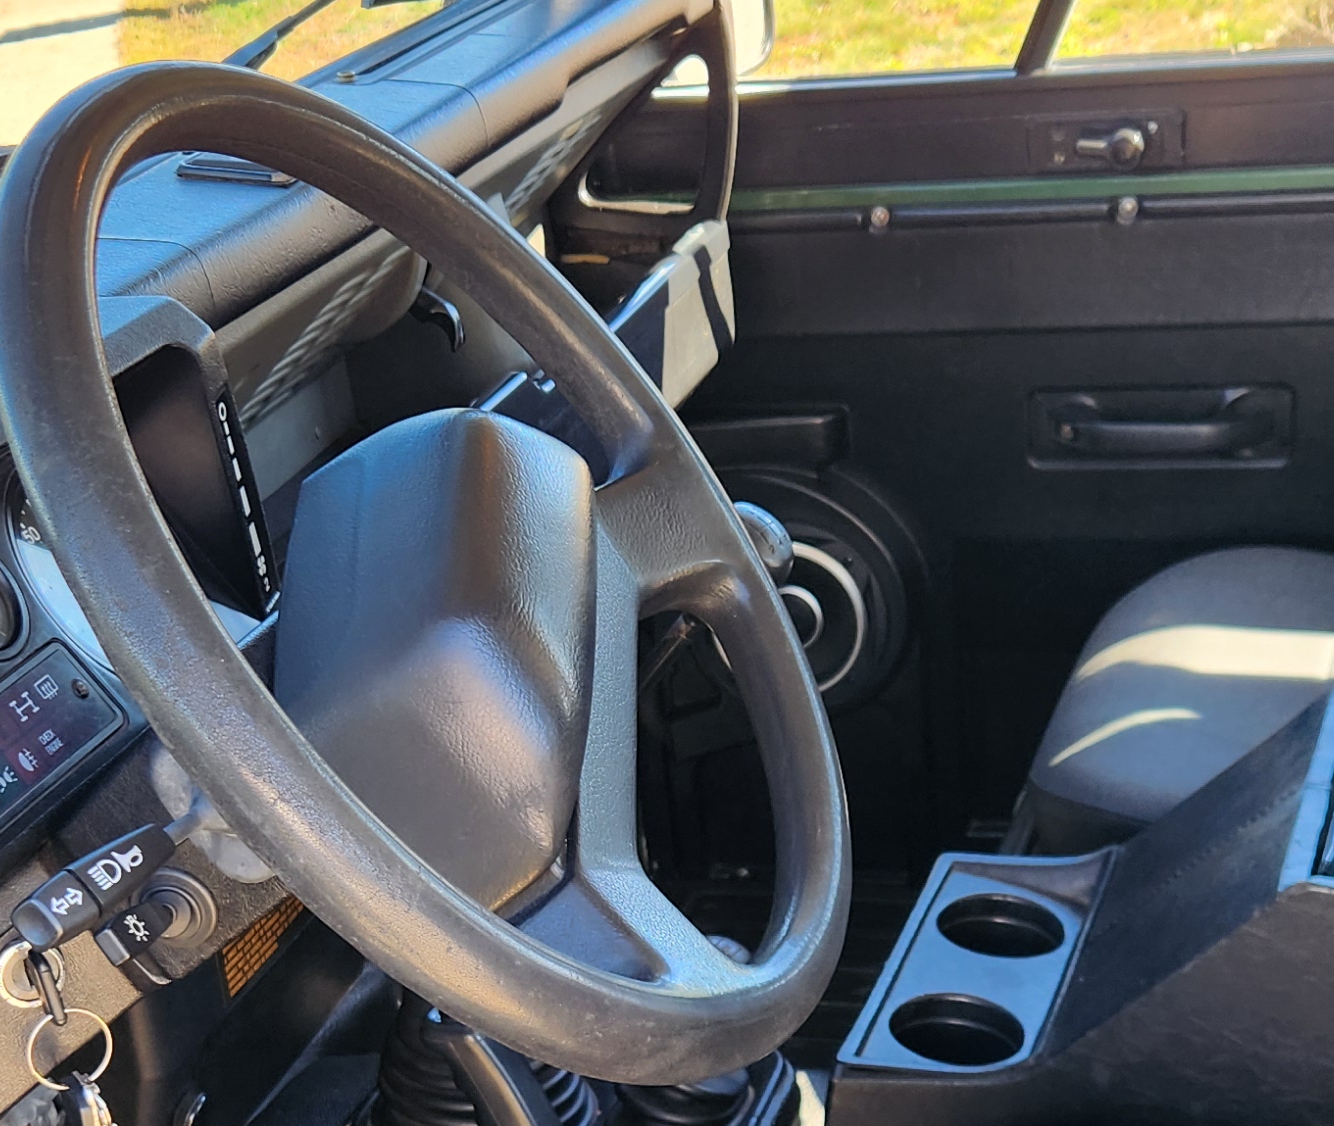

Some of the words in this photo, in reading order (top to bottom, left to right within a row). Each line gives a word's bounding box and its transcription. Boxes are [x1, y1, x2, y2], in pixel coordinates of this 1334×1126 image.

[20, 526, 42, 545] 50
[38, 729, 56, 745] CHECK
[45, 737, 64, 755] ENGINE
